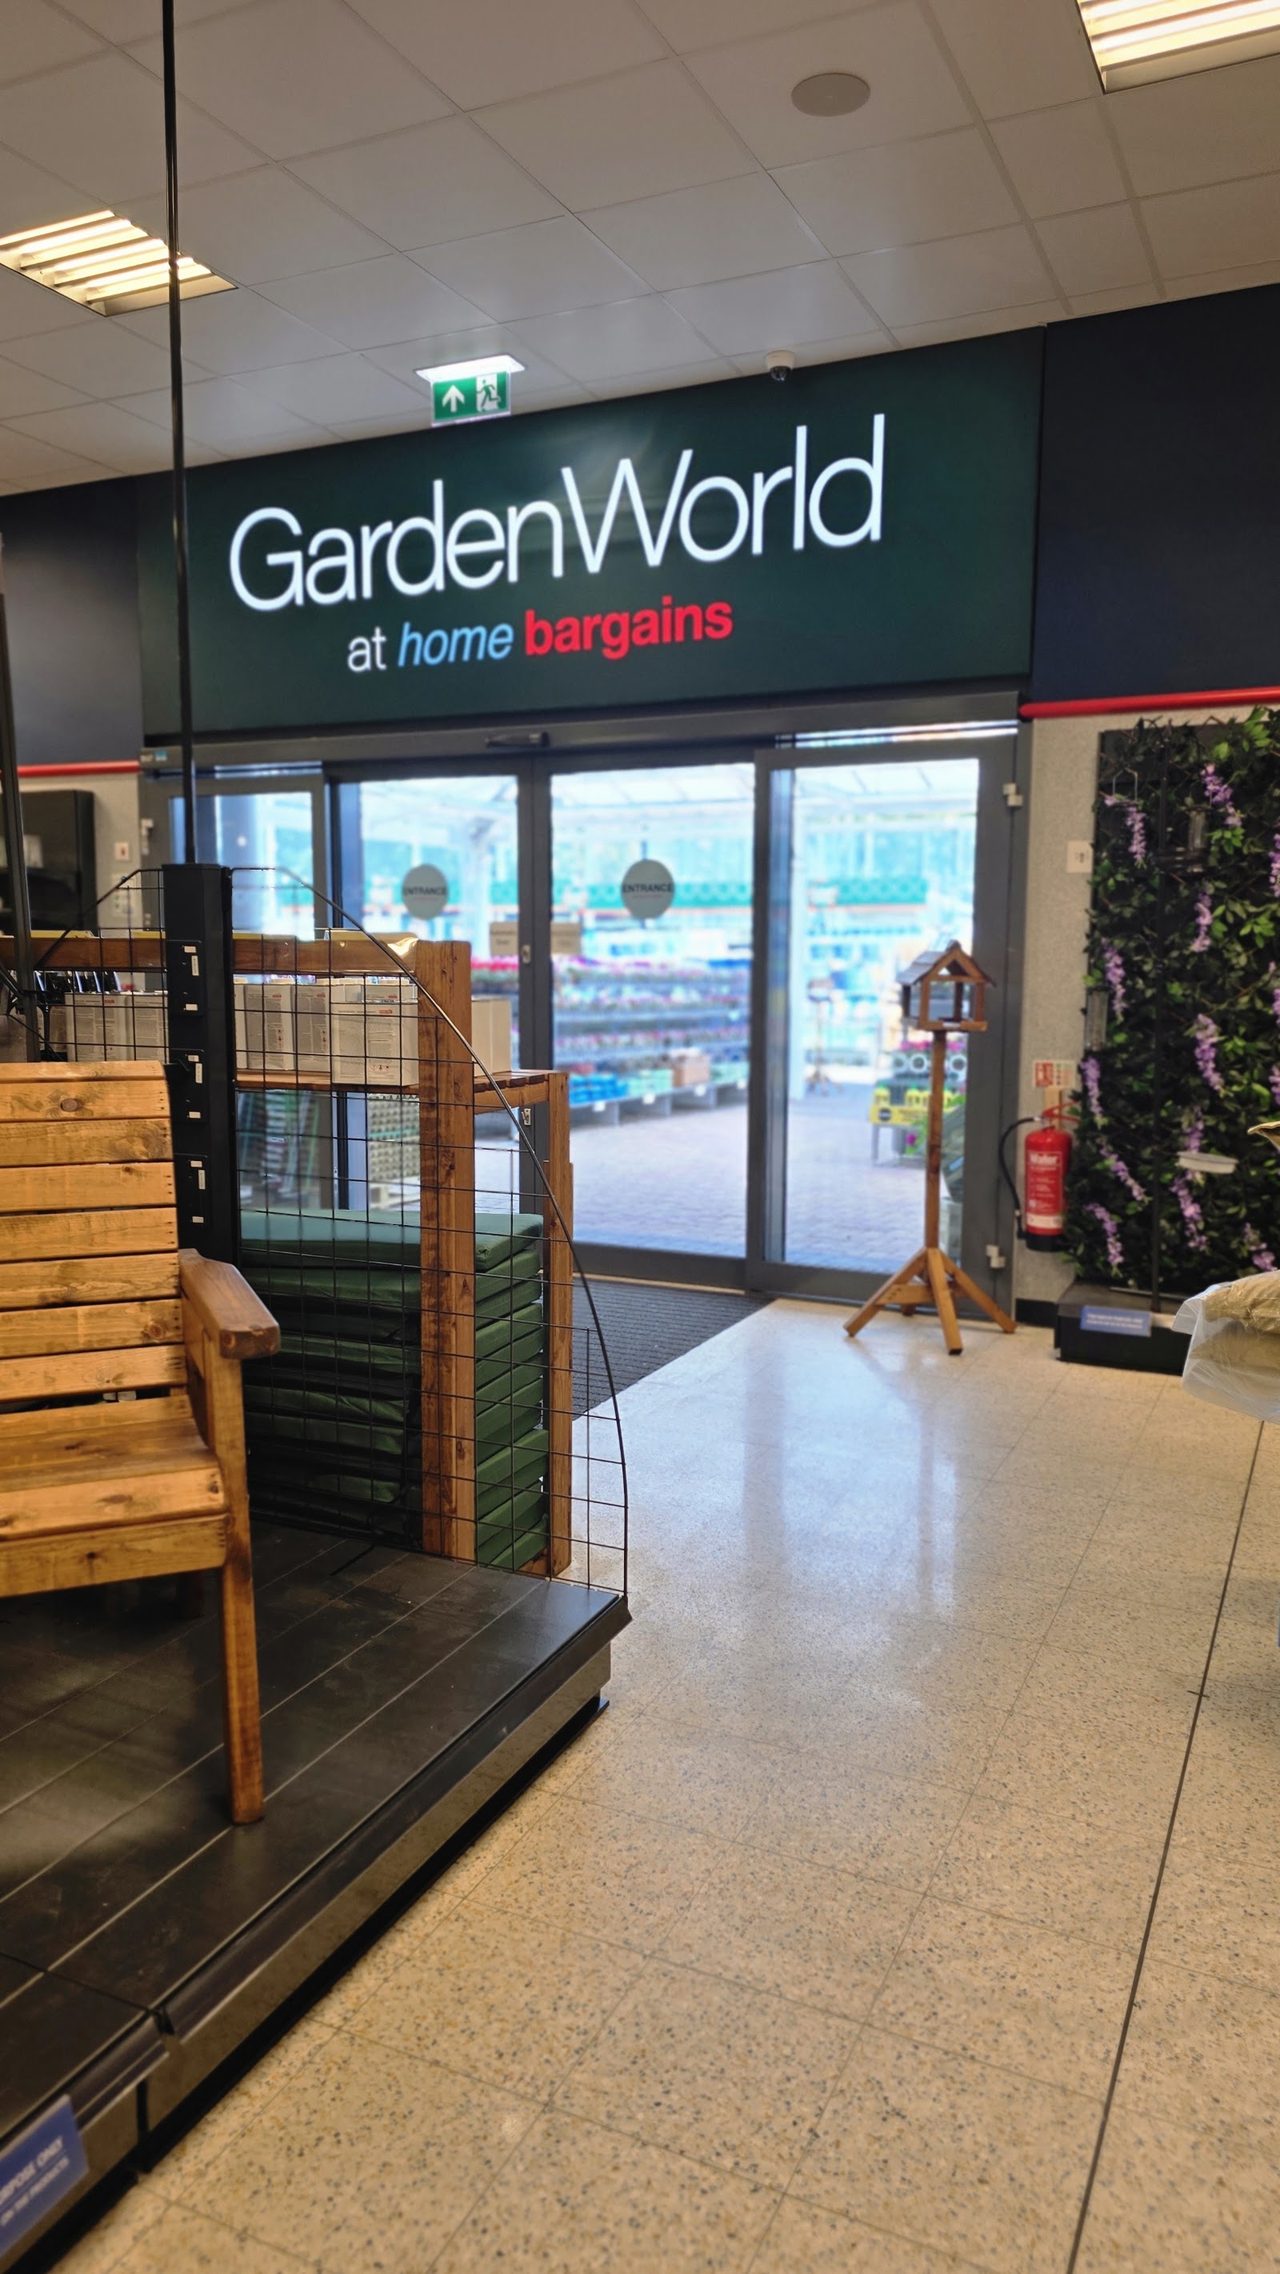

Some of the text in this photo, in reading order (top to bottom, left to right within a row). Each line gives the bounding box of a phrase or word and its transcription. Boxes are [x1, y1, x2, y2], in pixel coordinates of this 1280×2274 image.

[229, 413, 886, 612] GardenWorld
[347, 595, 734, 673] at home bargains
[622, 883, 674, 893] ENTRANCE
